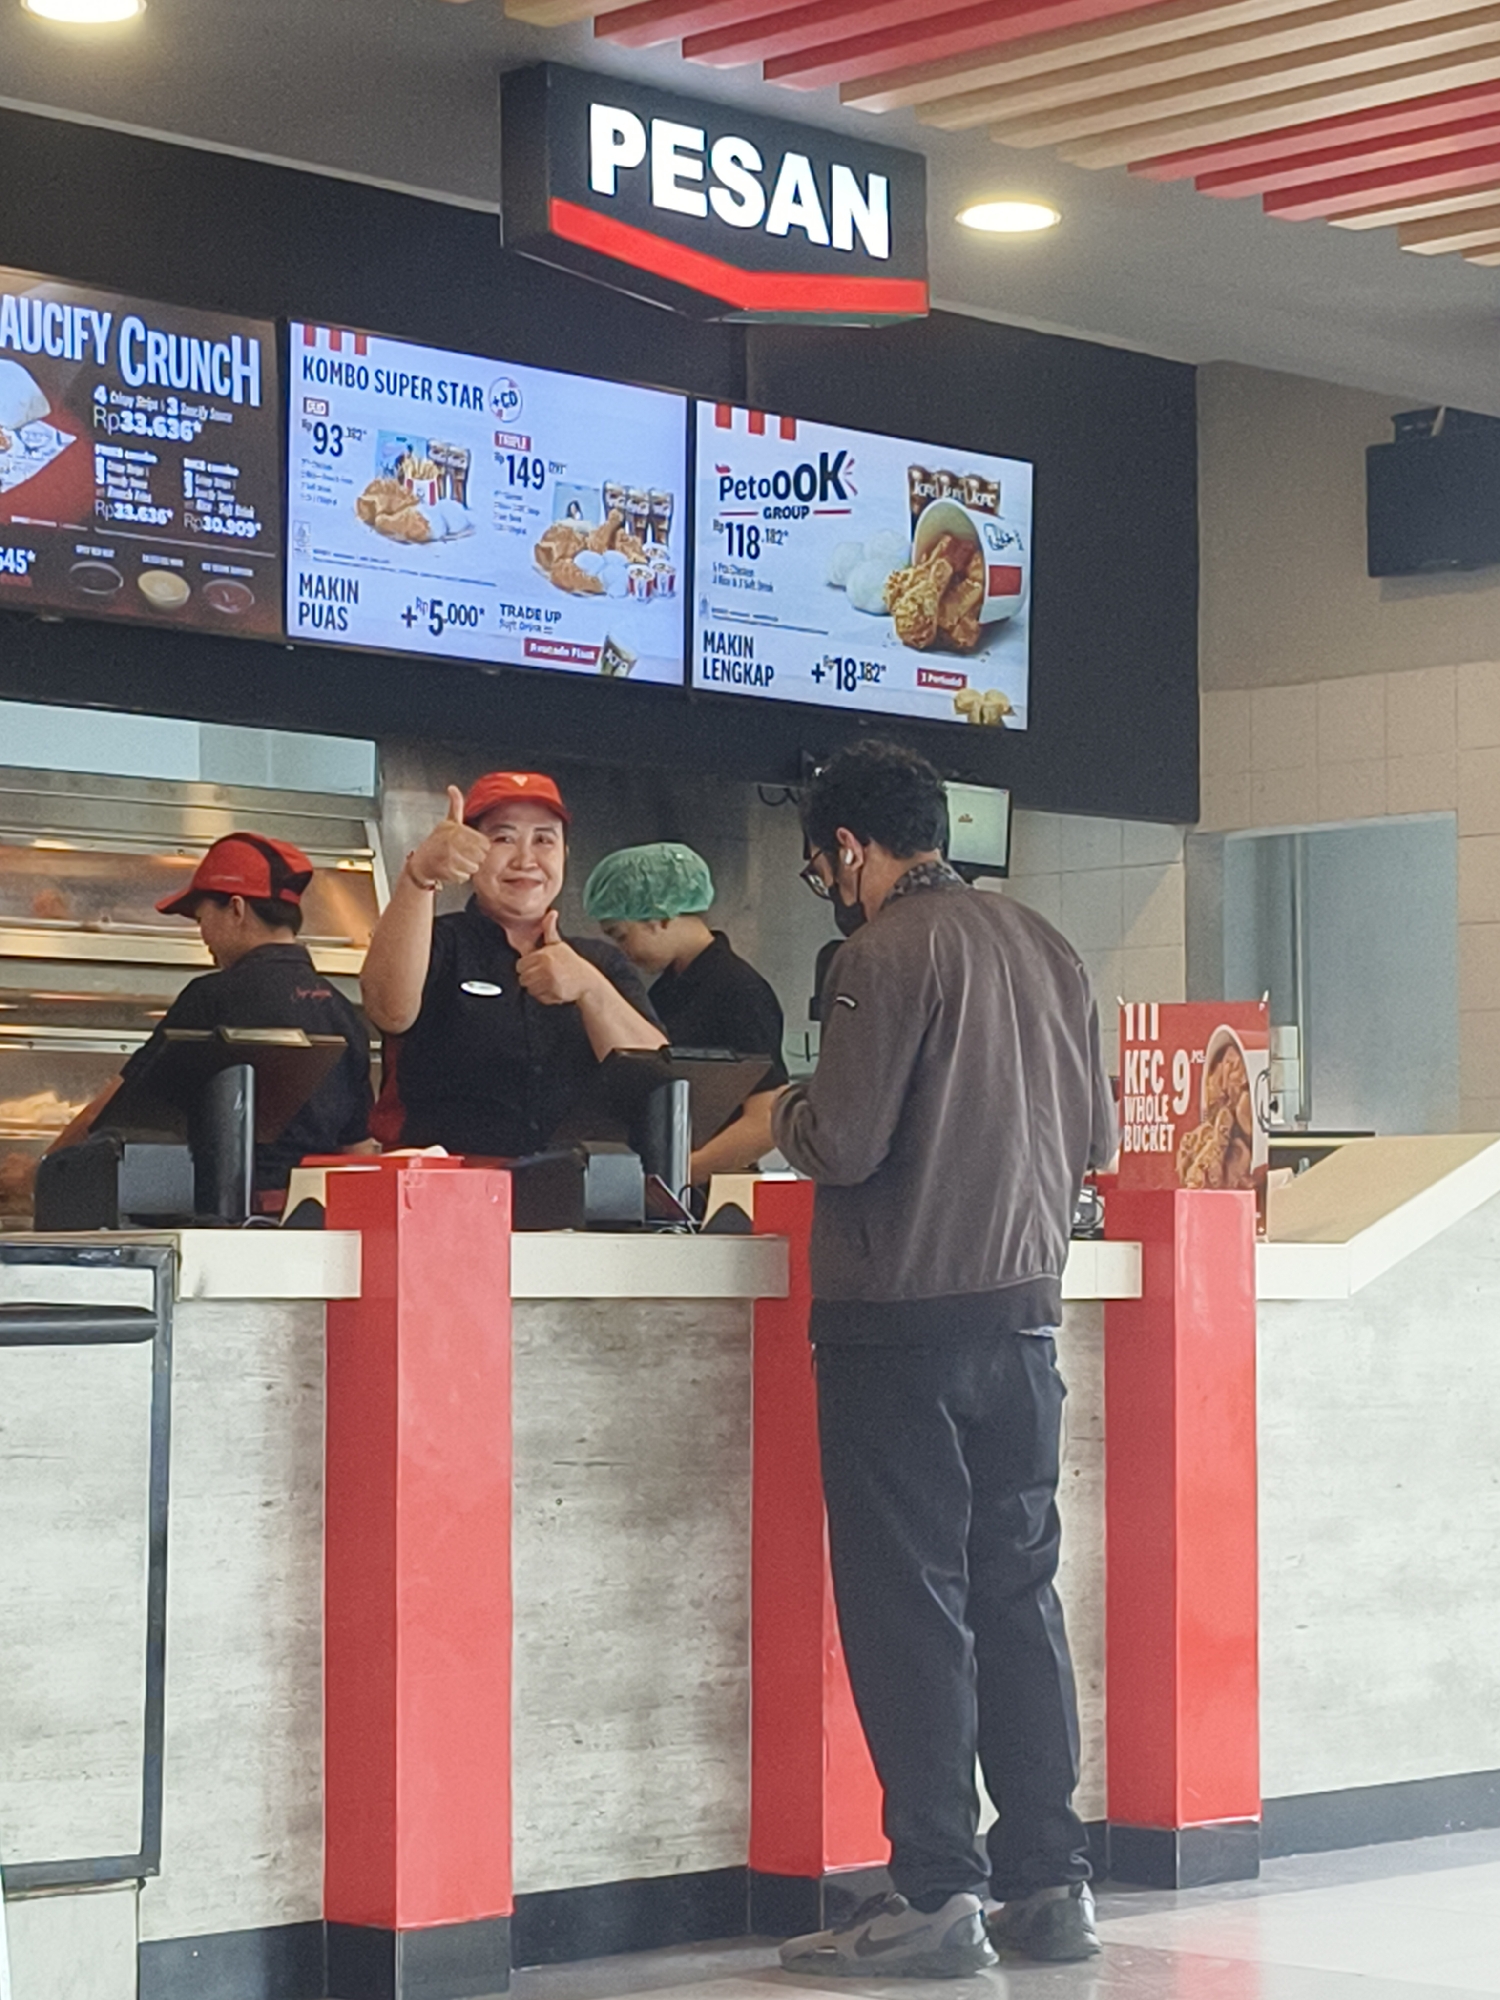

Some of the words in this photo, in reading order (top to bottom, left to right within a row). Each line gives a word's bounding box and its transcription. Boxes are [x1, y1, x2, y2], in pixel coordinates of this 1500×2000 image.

[589, 103, 890, 259] PESAN
[0, 294, 112, 365] AUCIFY
[94, 385, 108, 405] 4
[303, 355, 369, 390] KOMBO
[374, 369, 432, 402] SUPER
[437, 380, 484, 411] STAR
[763, 506, 810, 520] GROUP
[299, 573, 359, 604] MAKIN
[299, 602, 348, 632] PUAS
[499, 603, 542, 621] TRADE
[545, 609, 562, 624] UP
[703, 630, 754, 659] MAKIN
[703, 657, 774, 687] LENGKAP
[1124, 1049, 1165, 1095] KFC
[1172, 1049, 1191, 1116] 9
[1124, 1093, 1169, 1124] WHOLE
[1124, 1123, 1175, 1153] BUCKET
